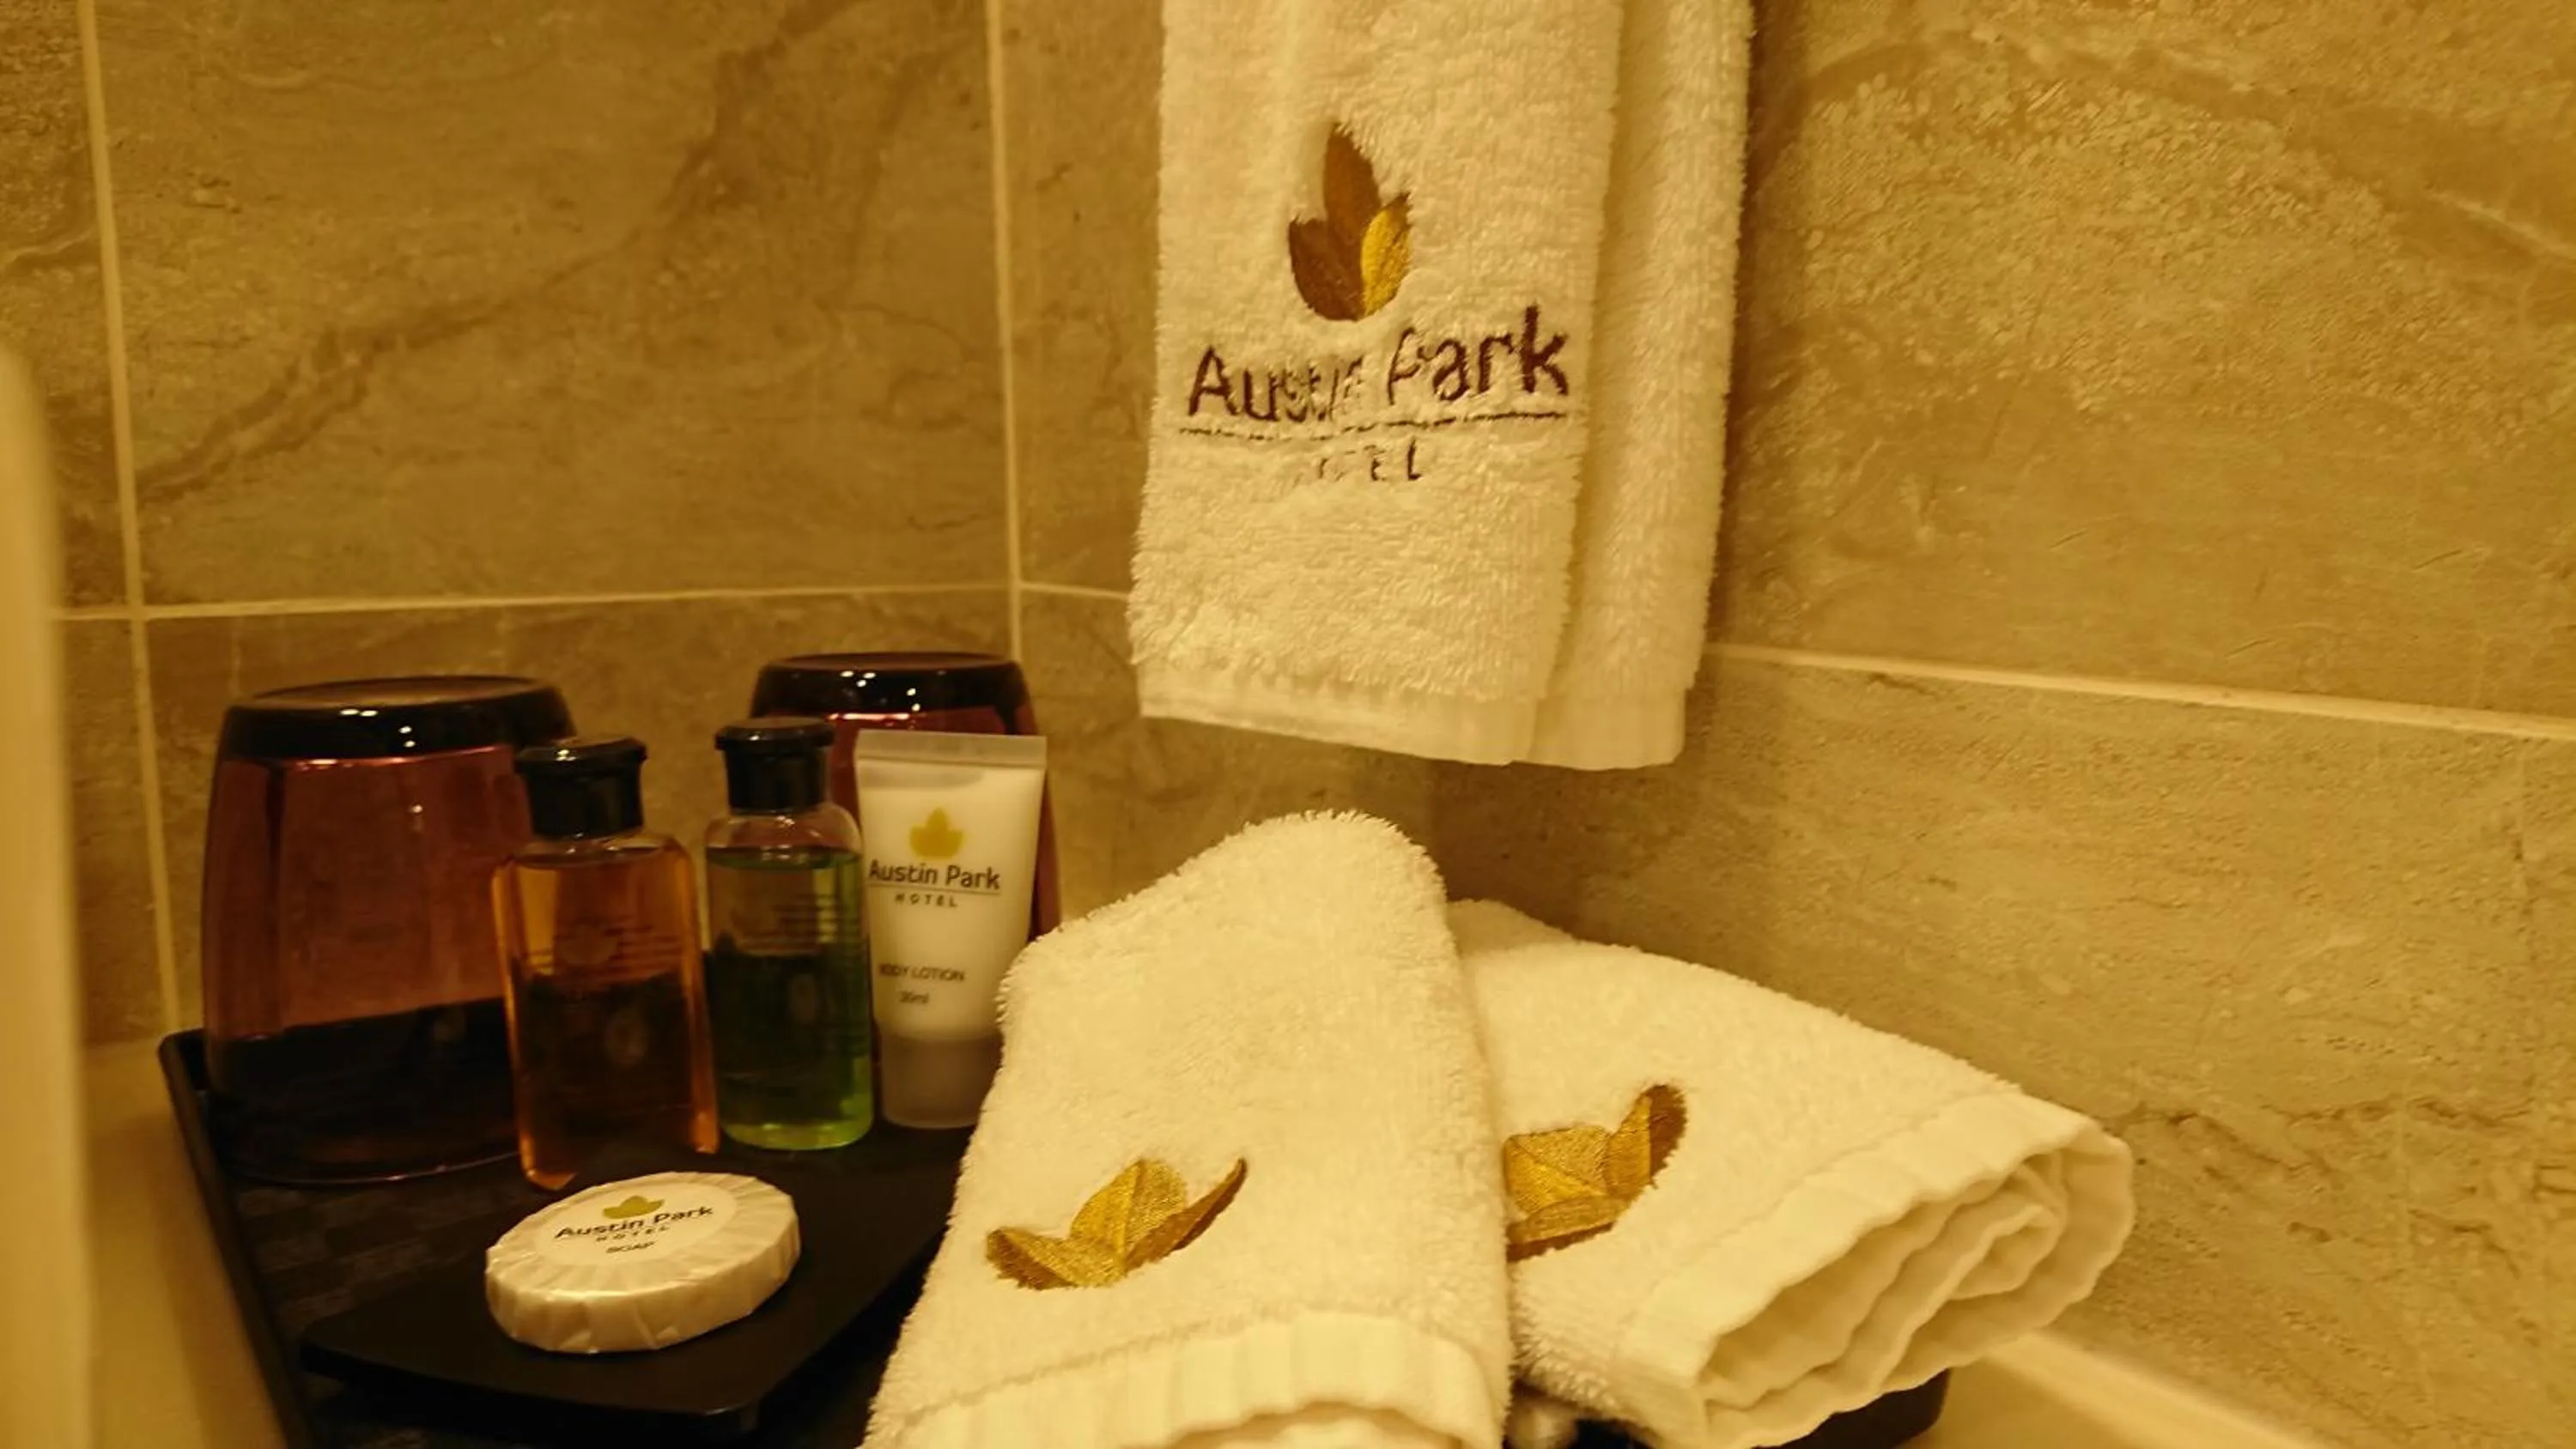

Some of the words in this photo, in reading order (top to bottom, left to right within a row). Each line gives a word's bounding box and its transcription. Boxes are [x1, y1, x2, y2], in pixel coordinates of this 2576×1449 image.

[1386, 301, 1570, 405] Park
[869, 860, 938, 884] Austin
[945, 864, 1000, 889] Park
[895, 893, 958, 907] HOTEL
[912, 966, 965, 982] LOTION
[555, 1219, 643, 1238] Austin
[654, 1206, 713, 1223] Park
[596, 1225, 669, 1241] HOTEL
[605, 1241, 654, 1253] SOAP
